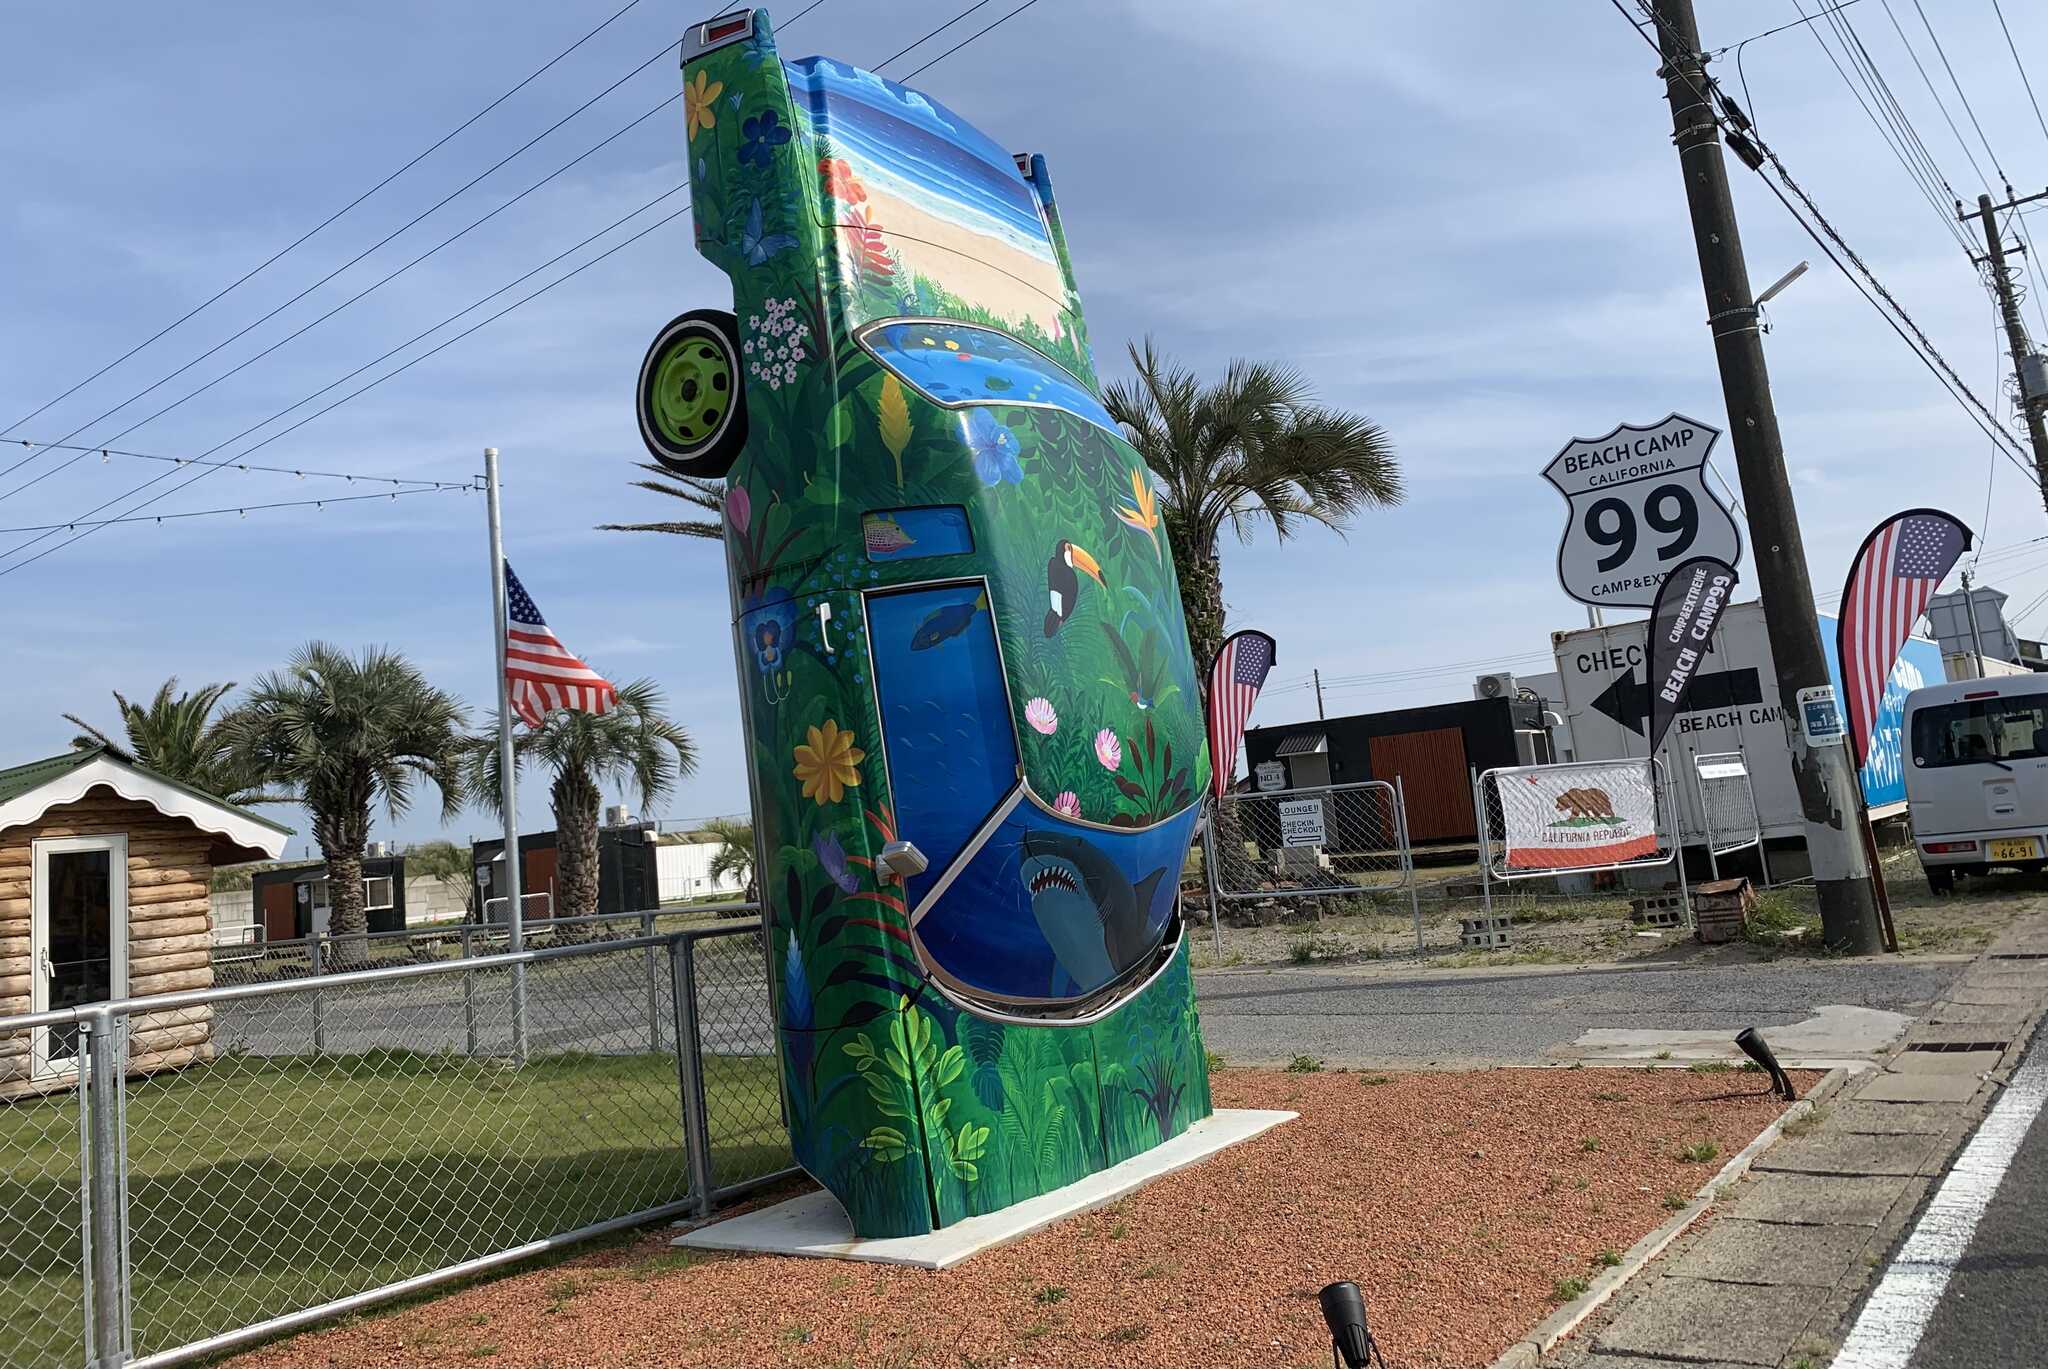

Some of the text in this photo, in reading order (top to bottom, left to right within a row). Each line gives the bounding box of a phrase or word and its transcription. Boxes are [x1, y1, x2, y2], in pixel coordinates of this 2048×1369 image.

[1564, 429, 1694, 474] BEACH CAMP
[1589, 458, 1675, 486] CALIFORNIA
[1584, 484, 1699, 573] 99
[1668, 568, 1707, 643] CAMP&EXTREME
[1659, 575, 1731, 703] BEACH CAMP99
[1679, 711, 1742, 733] BEACH
[1280, 805, 1312, 814] LOUNGE
[1281, 819, 1314, 828] CHECKIN
[1282, 826, 1323, 835] CHECKOUT
[1542, 832, 1591, 843] CALIFORNIA
